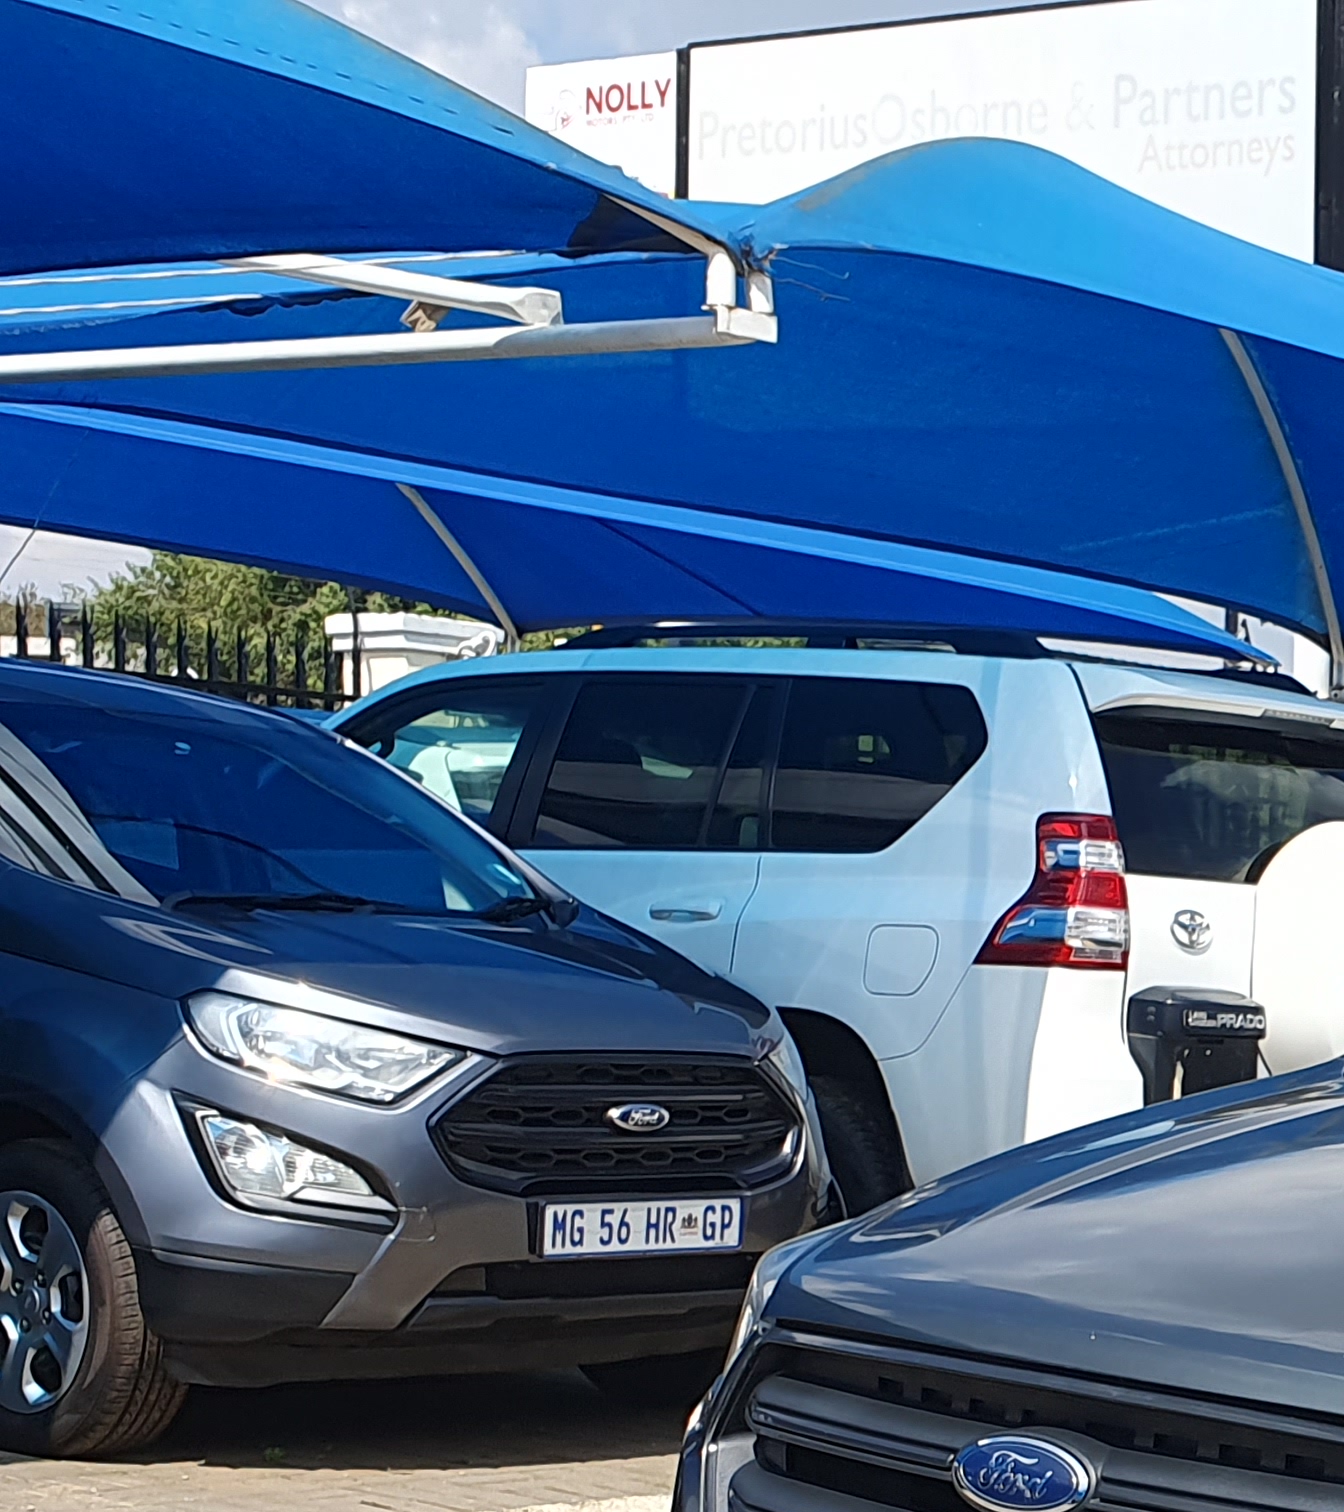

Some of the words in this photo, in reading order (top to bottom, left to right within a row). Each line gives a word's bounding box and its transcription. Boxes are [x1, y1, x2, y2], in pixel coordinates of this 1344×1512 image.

[585, 77, 671, 115] NOLLY
[1065, 80, 1097, 132] &
[1111, 72, 1297, 129] Partners
[586, 117, 617, 127] MOTORS
[1136, 132, 1296, 177] Attorneys
[1216, 1013, 1265, 1030] PRADO
[627, 1107, 660, 1127] Ford
[551, 1208, 585, 1249] MG
[599, 1207, 631, 1246] 56
[645, 1206, 677, 1245] HR
[702, 1204, 734, 1242] GP
[977, 1450, 1054, 1500] Ford
